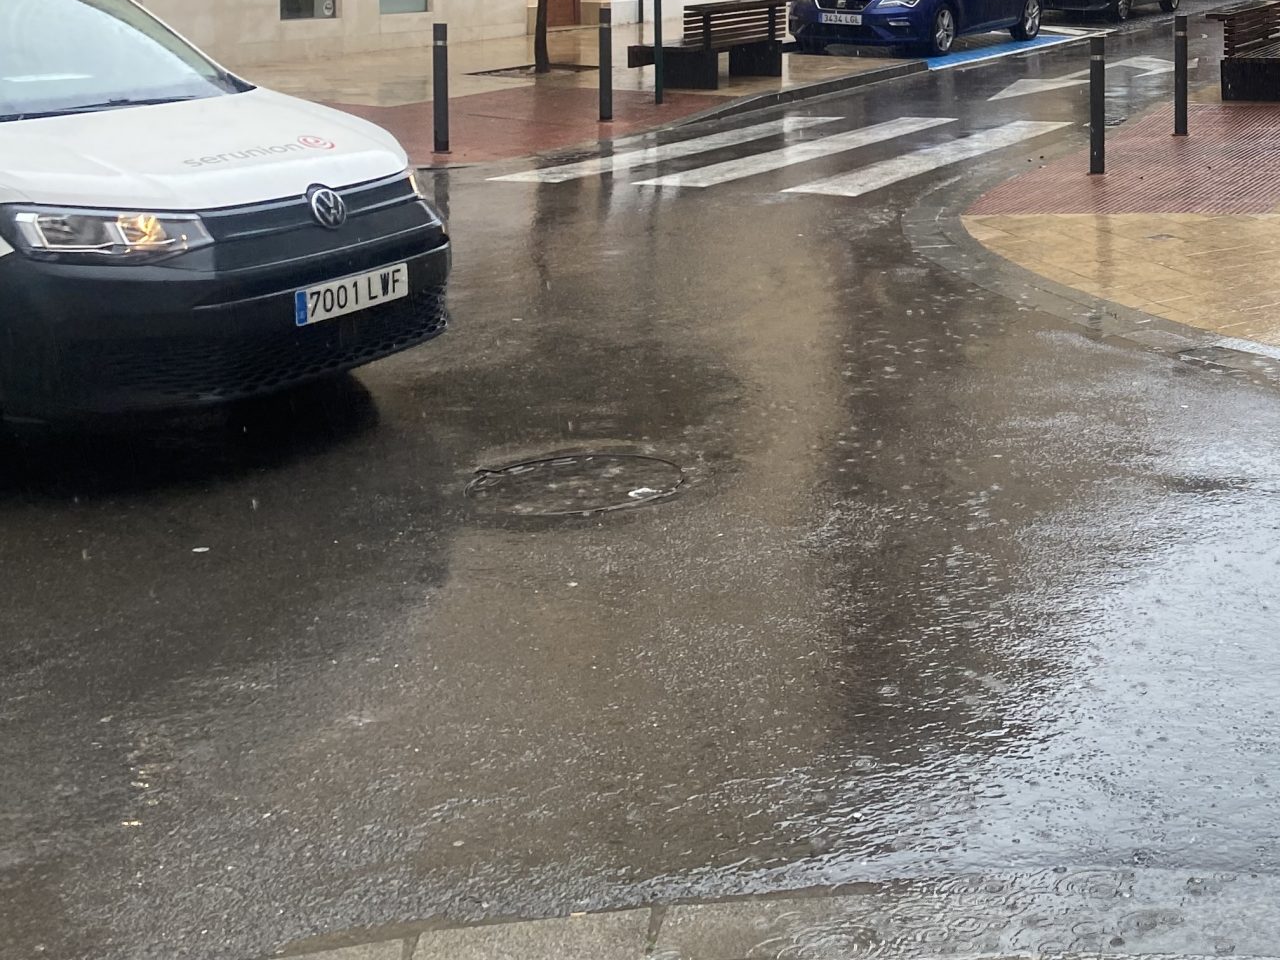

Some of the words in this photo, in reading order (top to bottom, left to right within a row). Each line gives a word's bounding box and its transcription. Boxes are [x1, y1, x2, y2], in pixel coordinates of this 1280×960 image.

[183, 142, 305, 168] serunion
[309, 281, 359, 318] 7001
[368, 268, 401, 301] LWF
